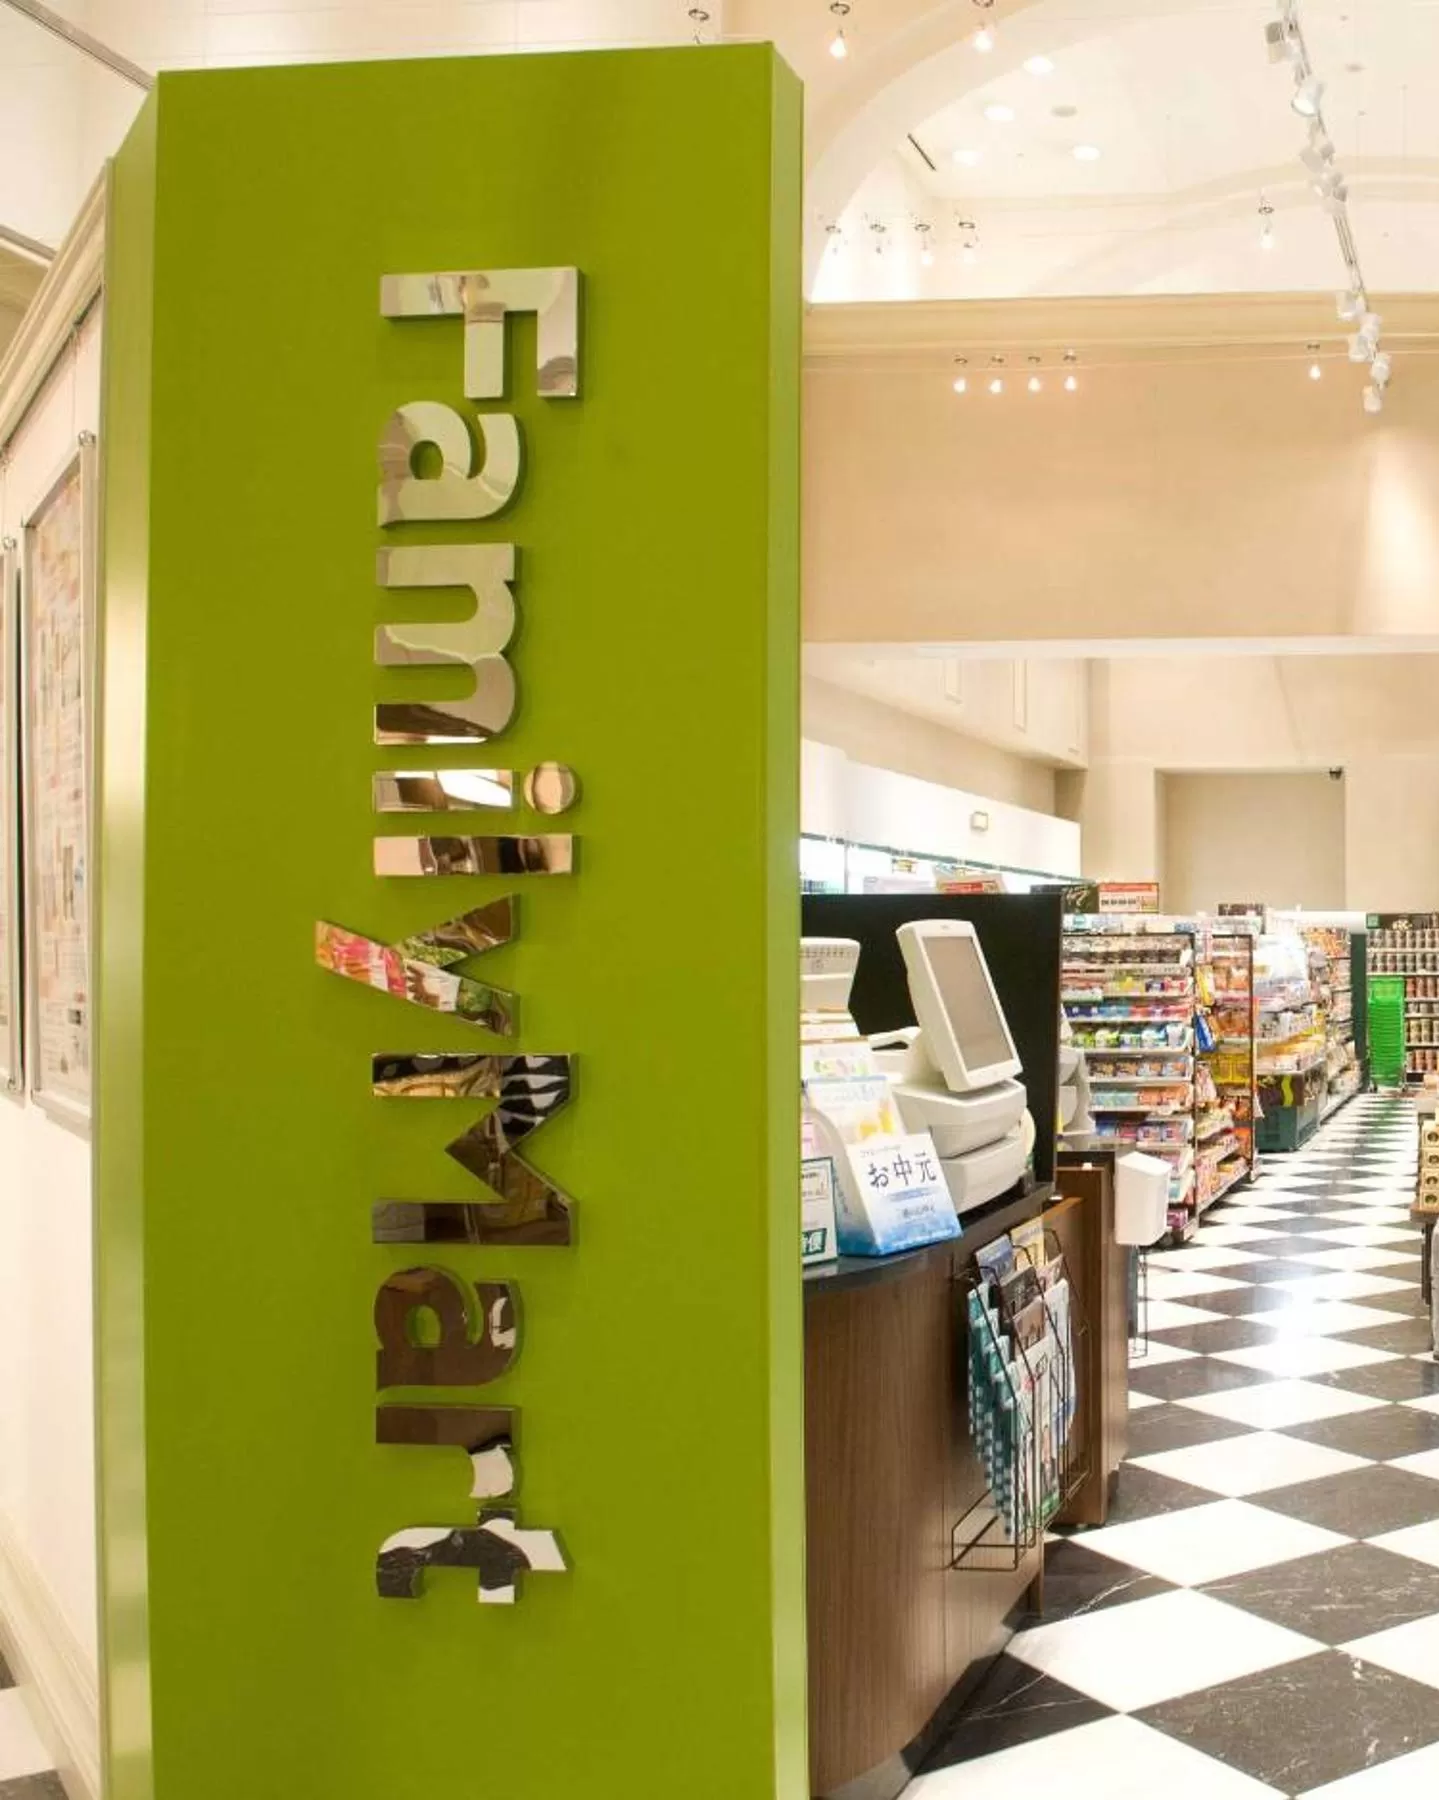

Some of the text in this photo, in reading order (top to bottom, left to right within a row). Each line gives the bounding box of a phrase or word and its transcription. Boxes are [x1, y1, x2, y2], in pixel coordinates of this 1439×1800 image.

[315, 267, 582, 1604] FamilyMart
[867, 1150, 938, 1188] お中元
